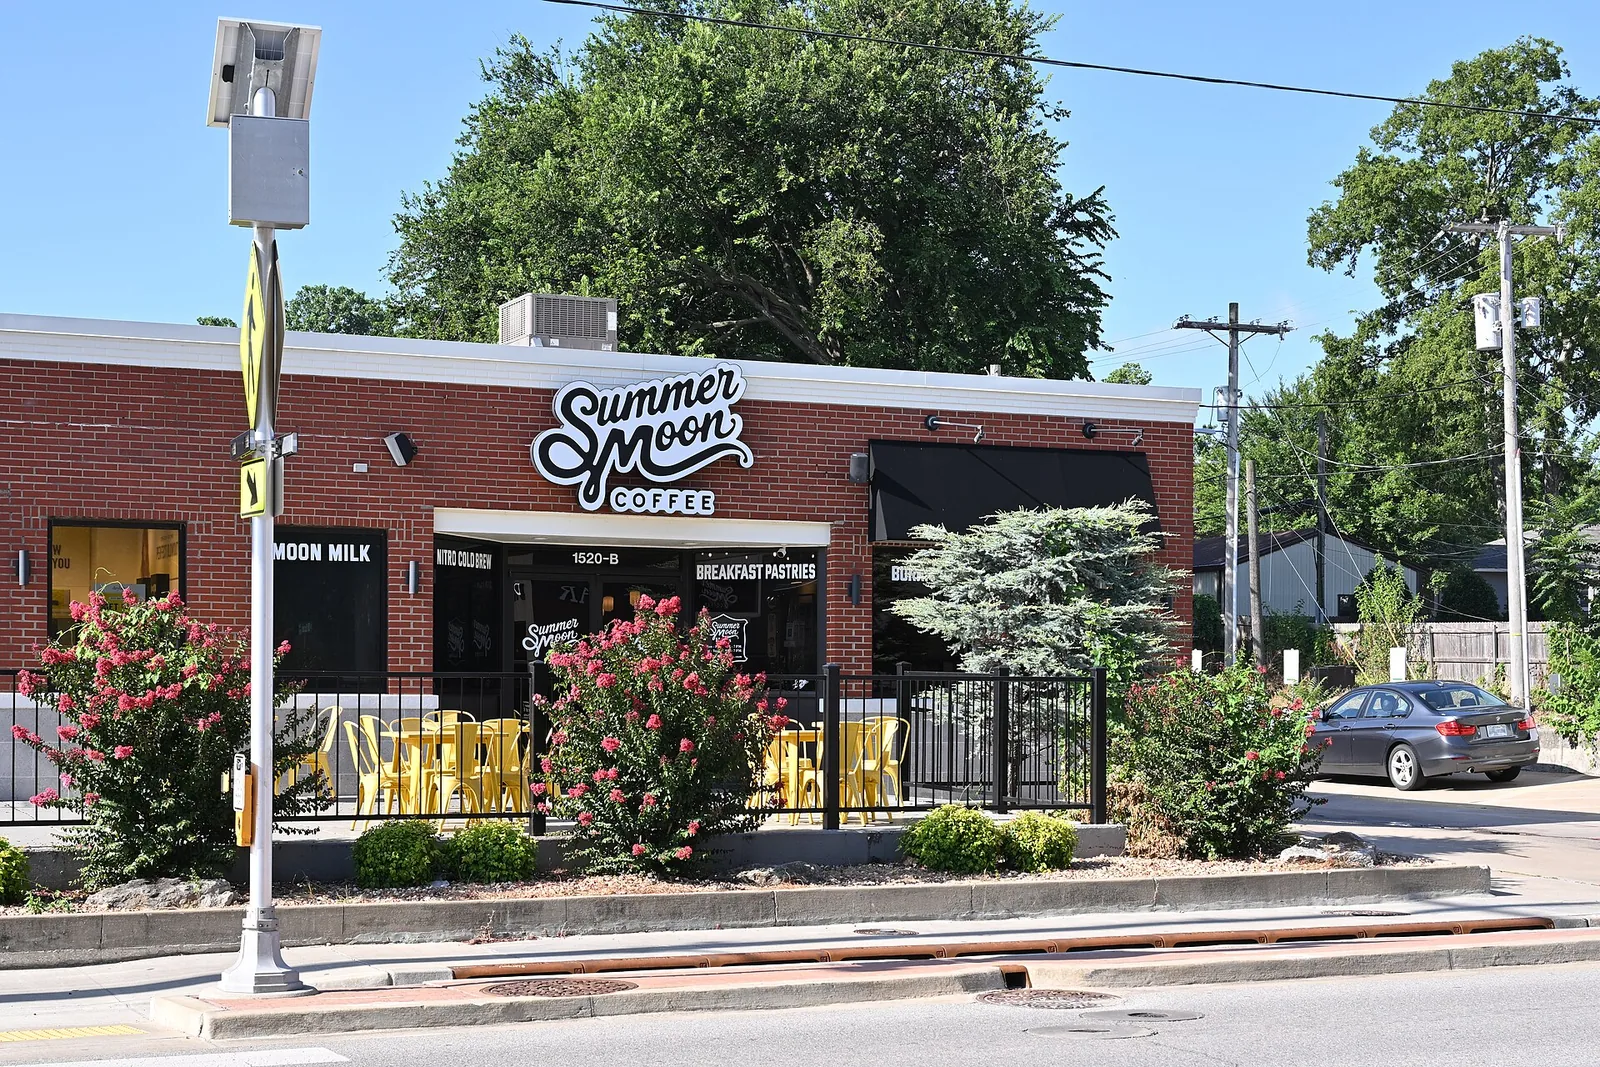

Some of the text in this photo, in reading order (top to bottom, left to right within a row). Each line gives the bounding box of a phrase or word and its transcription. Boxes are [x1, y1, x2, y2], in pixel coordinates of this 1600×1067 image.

[539, 368, 739, 478] Summer
[583, 410, 748, 503] Moon
[615, 491, 711, 510] COFFEE
[273, 543, 371, 562] MOON MILK
[436, 549, 492, 569] NITRO COLD BREW
[572, 552, 619, 565] 1520-B
[52, 558, 70, 569] YOU
[696, 563, 816, 580] BREAKFAST PASTRIES
[522, 618, 579, 650] Summer
[534, 630, 580, 657] Moon
